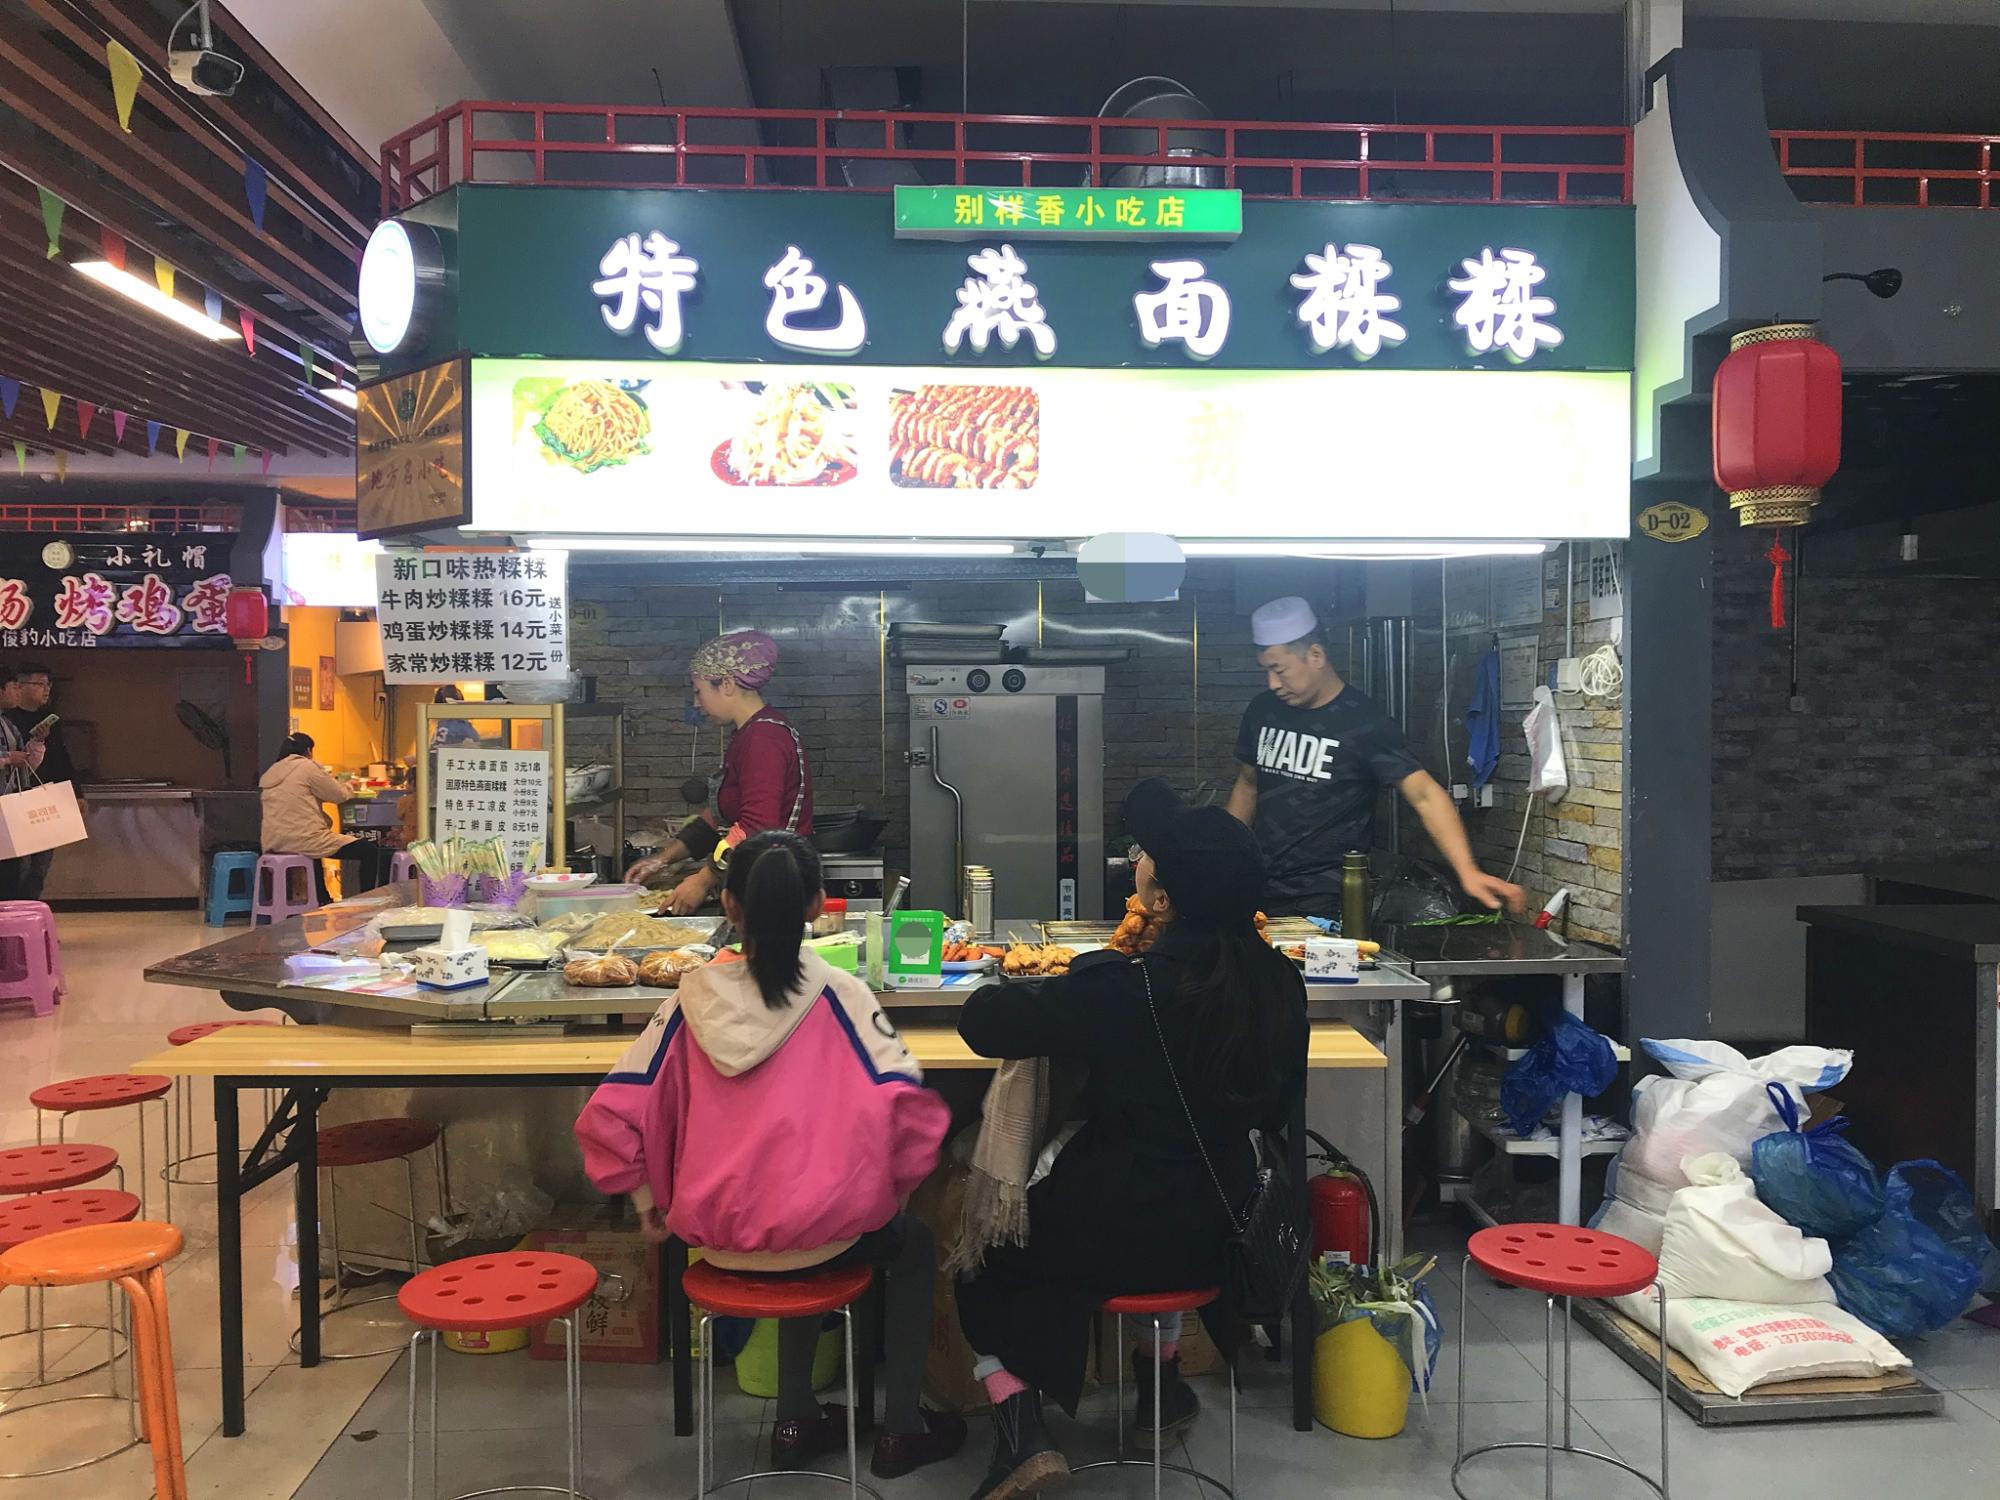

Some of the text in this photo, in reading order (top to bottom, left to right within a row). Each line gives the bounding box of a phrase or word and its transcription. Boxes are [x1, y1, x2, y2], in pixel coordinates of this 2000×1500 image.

[954, 194, 1185, 227] 别样香小吃店
[590, 230, 1564, 362] 特色燕面糅糅
[1647, 512, 1690, 531] D-02
[106, 545, 207, 570] 小礼帽
[393, 556, 548, 581] 新口味热糅糅
[55, 573, 231, 635] 烤鸡蛋
[380, 588, 546, 610] 牛肉炒糅糅 16元
[383, 619, 547, 642] 鸡蛋炒糅糅 14元
[548, 596, 563, 663] 送小菜一份
[387, 651, 548, 674] 家常炒糅糅 12元
[1257, 726, 1340, 780] WADE
[512, 822, 539, 833] 8元1份
